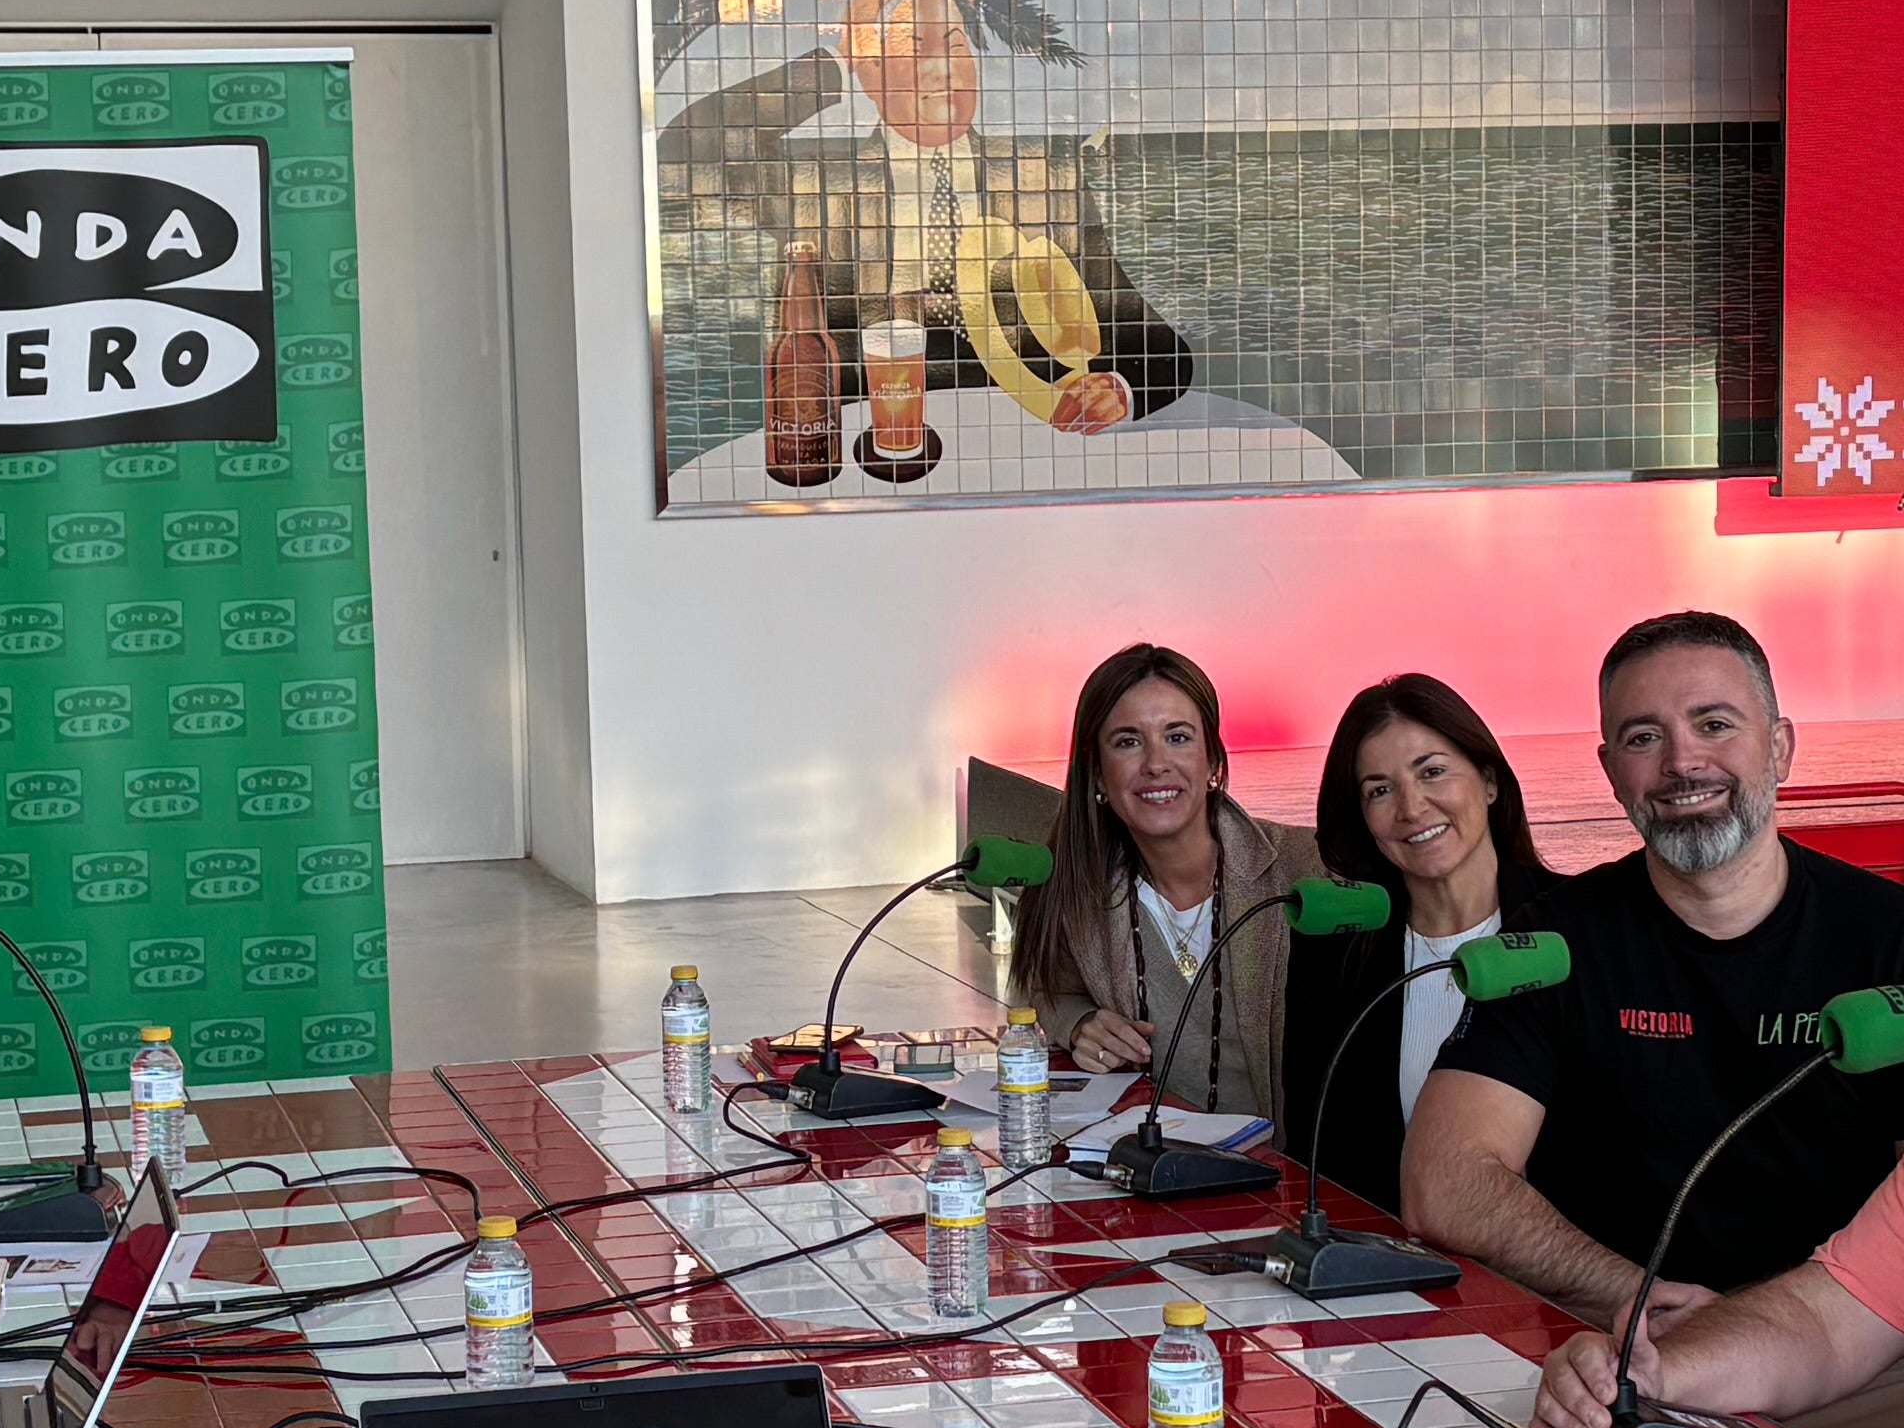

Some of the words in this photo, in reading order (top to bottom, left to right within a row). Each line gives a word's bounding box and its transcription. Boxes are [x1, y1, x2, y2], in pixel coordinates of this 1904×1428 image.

[102, 84, 160, 96] ONDA
[219, 82, 276, 96] ONDA
[108, 104, 160, 120] CERO
[224, 104, 276, 120] CERO
[282, 168, 337, 180] ONDA
[287, 190, 337, 204] CERO
[289, 344, 343, 357] ONDA
[292, 367, 344, 382] CERO
[769, 417, 837, 435] VICTORIA
[115, 459, 167, 472] CERO
[229, 457, 281, 471] CERO
[58, 523, 114, 536] ONDA
[173, 520, 228, 534] ONDA
[286, 516, 342, 530] ONDA
[62, 544, 115, 560] CERO
[177, 542, 229, 556] CERO
[290, 538, 342, 553] CERO
[116, 612, 172, 624] ONDA
[230, 610, 284, 622] ONDA
[2, 636, 54, 650] CERO
[122, 633, 172, 647] CERO
[235, 632, 285, 646] CERO
[64, 697, 120, 710] ONDA
[179, 694, 234, 707] ONDA
[292, 690, 346, 703] ONDA
[69, 718, 122, 732] CERO
[183, 716, 234, 730] CERO
[296, 712, 347, 726] CERO
[16, 782, 70, 794] ONDA
[134, 778, 189, 790] ONDA
[247, 776, 301, 788] ONDA
[20, 802, 72, 816] CERO
[138, 800, 190, 813] CERO
[252, 798, 302, 810] CERO
[82, 860, 137, 875] ONDA
[196, 860, 250, 872] ONDA
[306, 854, 362, 867] ONDA
[86, 882, 138, 898] CERO
[200, 881, 251, 894] CERO
[312, 876, 362, 890] CERO
[140, 948, 194, 961] ONDA
[251, 946, 306, 958] ONDA
[144, 970, 196, 983] CERO
[256, 967, 306, 980] CERO
[312, 1022, 366, 1036] ONDA
[1619, 1009, 1693, 1035] VICTORIA
[1758, 1013, 1783, 1045] LA
[200, 1028, 254, 1040] ONDA
[204, 1049, 254, 1062] CERO
[316, 1044, 366, 1058] CERO
